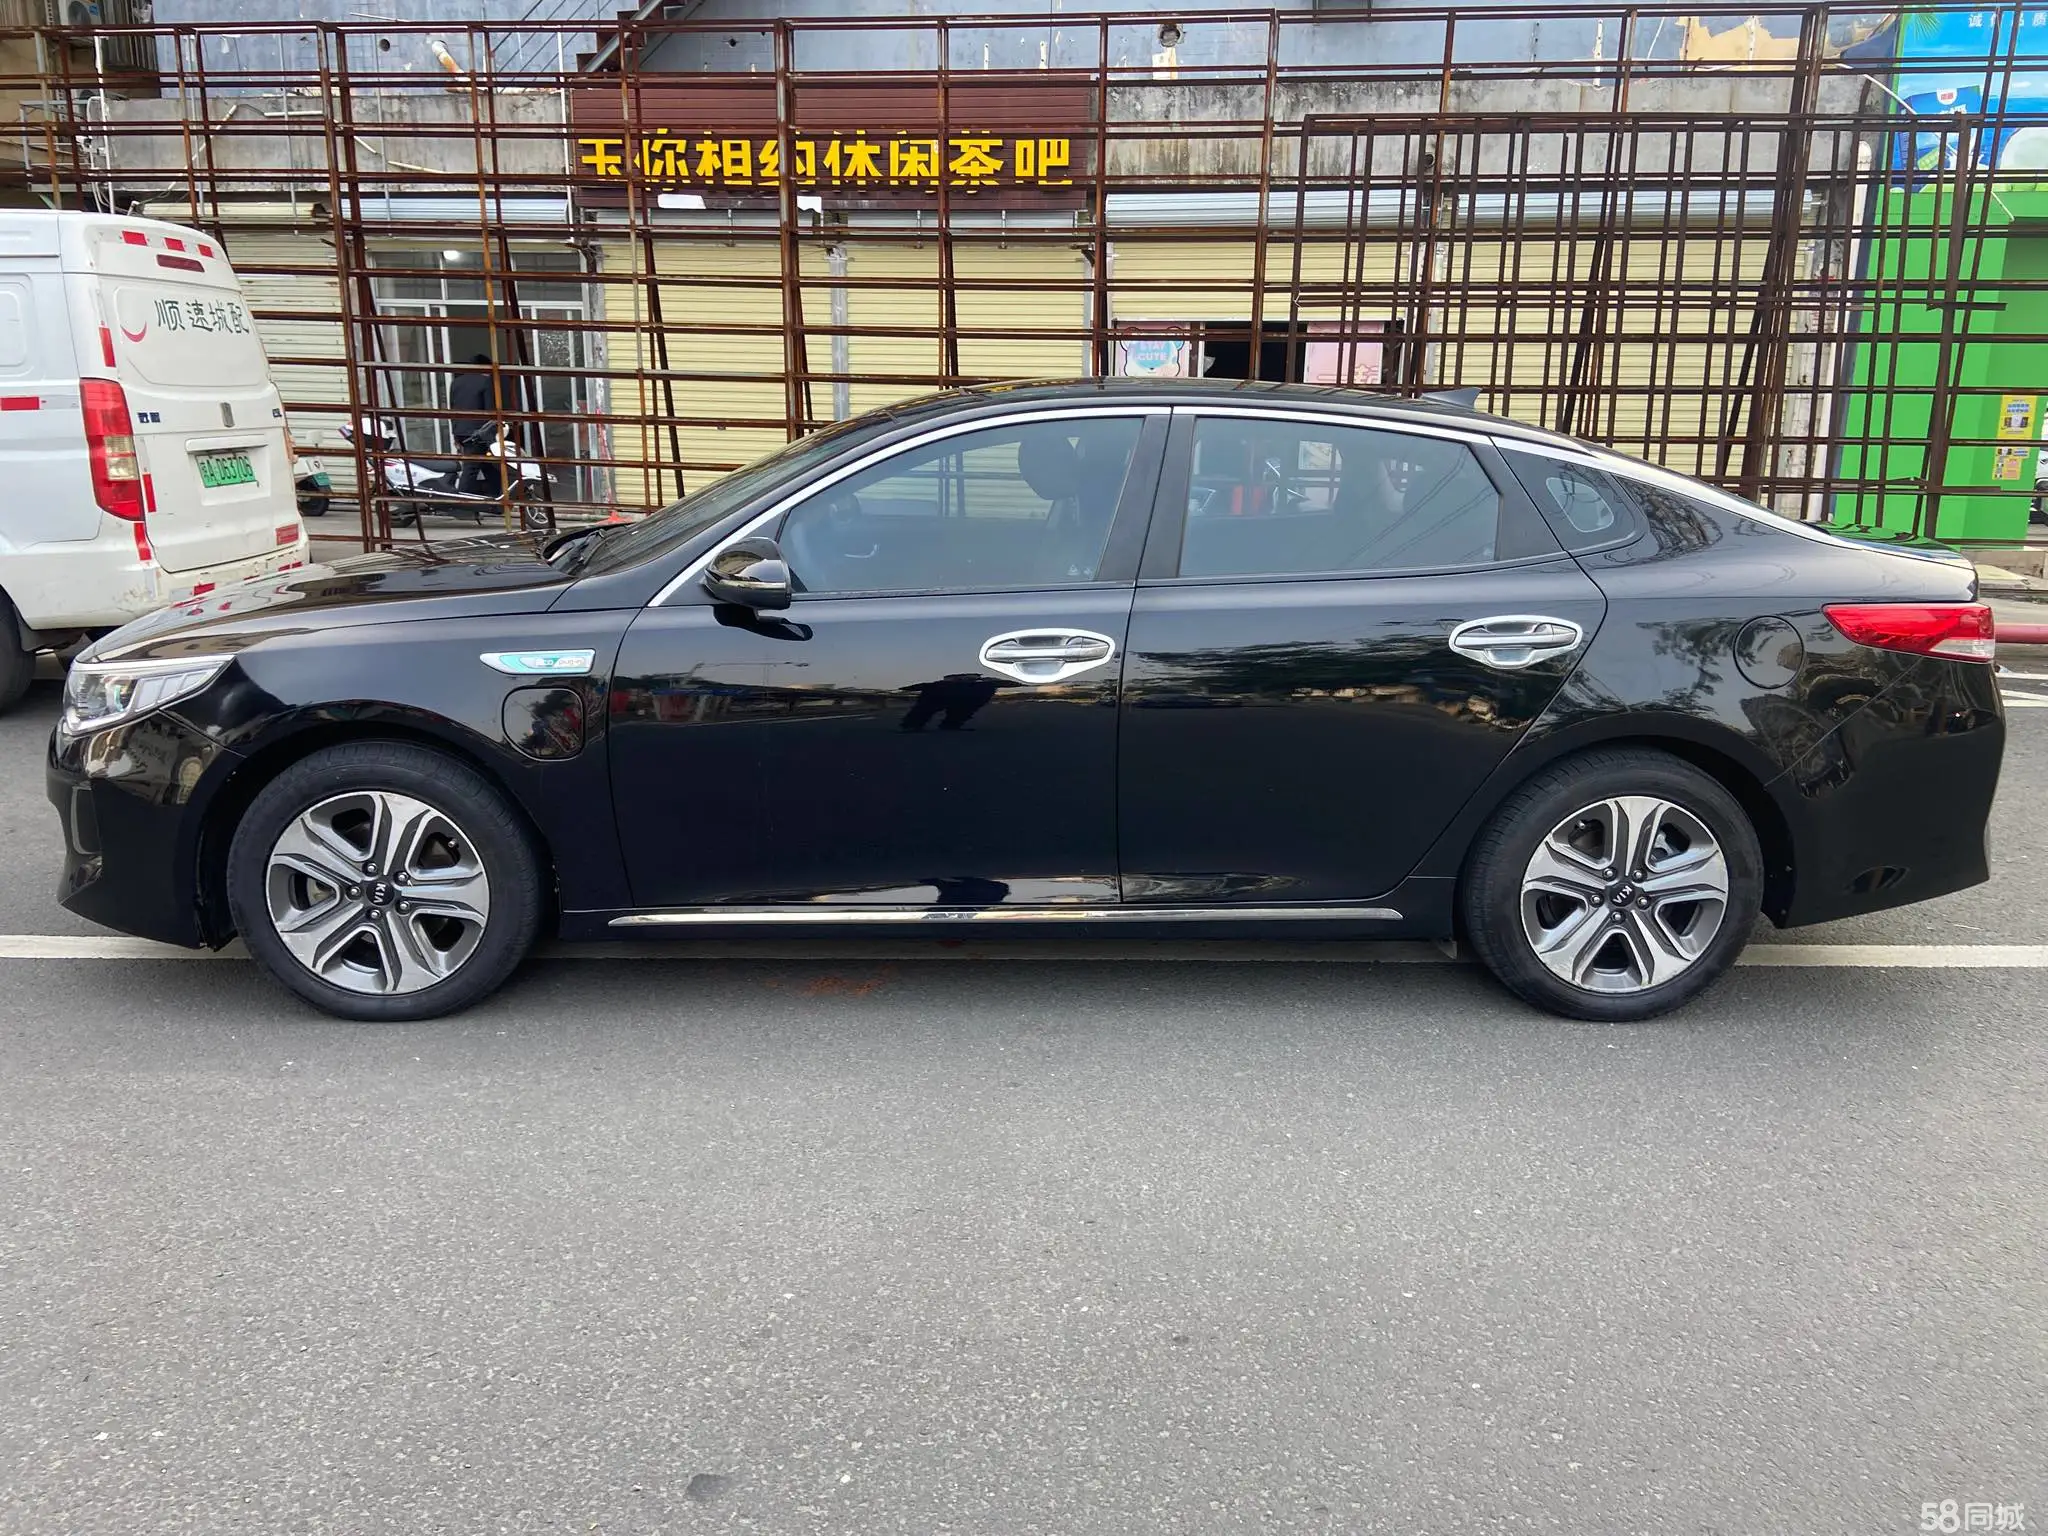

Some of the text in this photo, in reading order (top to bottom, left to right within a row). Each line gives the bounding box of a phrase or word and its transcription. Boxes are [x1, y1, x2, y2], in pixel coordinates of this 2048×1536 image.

[153, 299, 250, 334] 顺速城配
[374, 883, 386, 903] KIA
[1612, 885, 1633, 904] KIA
